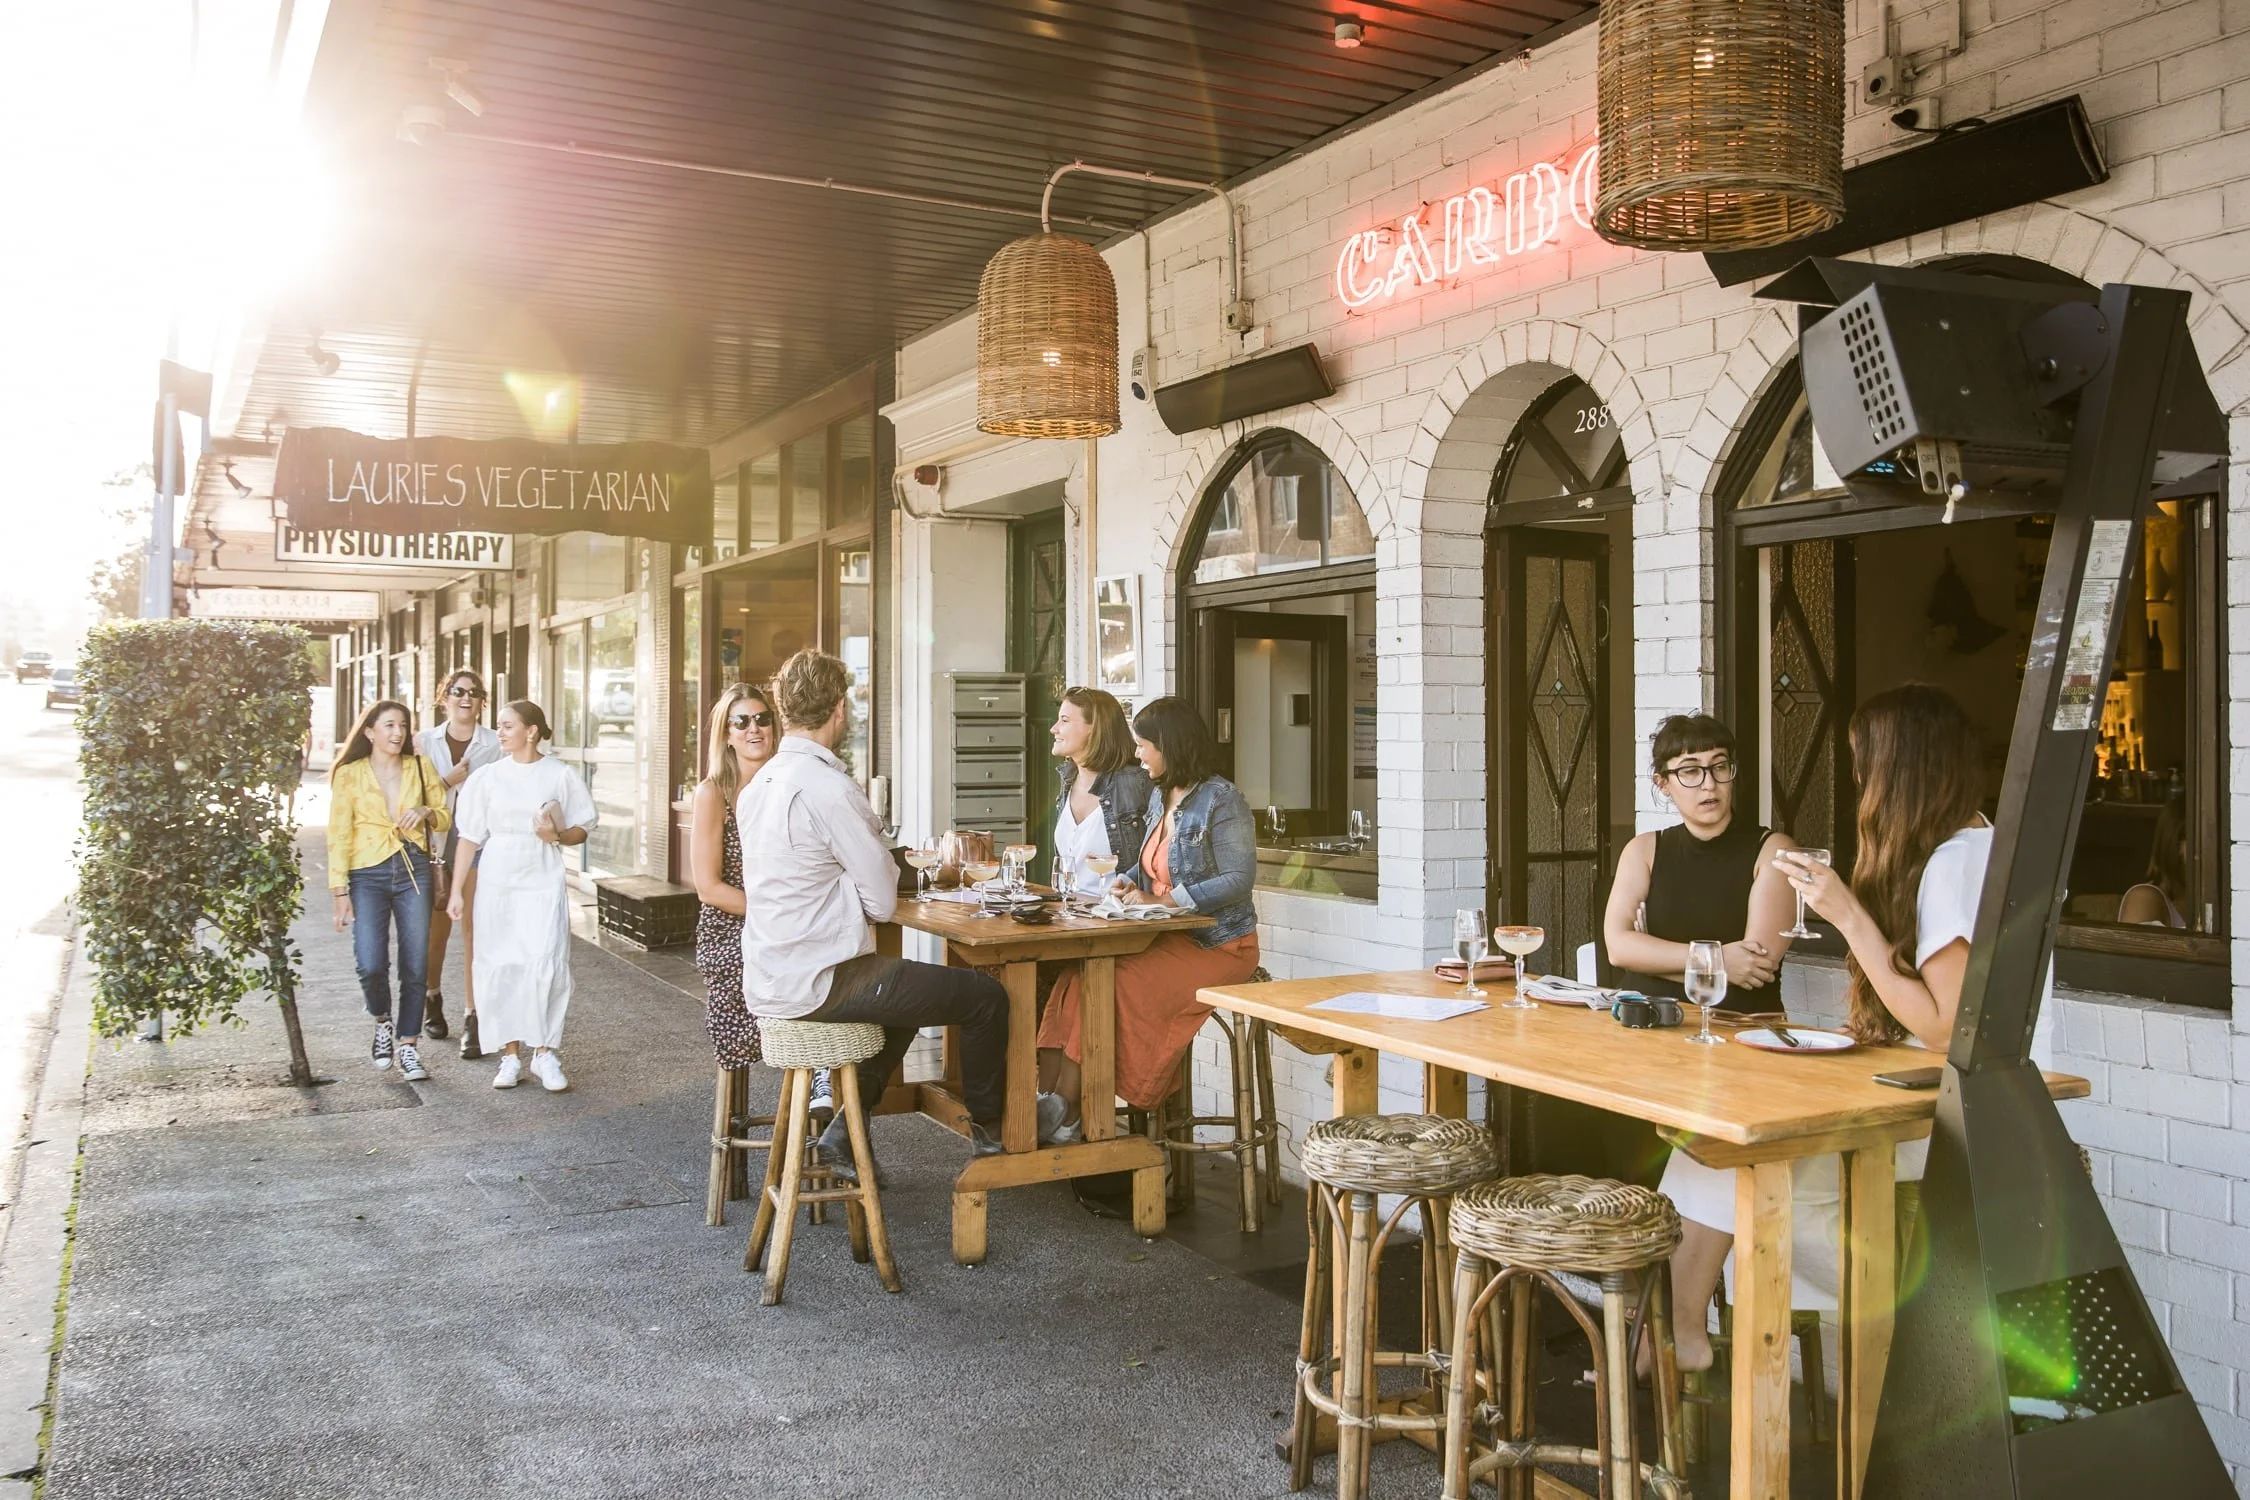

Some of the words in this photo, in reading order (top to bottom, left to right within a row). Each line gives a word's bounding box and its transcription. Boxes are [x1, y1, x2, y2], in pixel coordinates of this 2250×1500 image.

[1574, 404, 1609, 434] 288
[1920, 453, 1937, 463] OFF
[1944, 455, 1957, 465] ON
[327, 458, 467, 507] LAURIES
[476, 465, 671, 513] VEGETARIAN
[283, 525, 505, 563] PHYSIOTHERAPY
